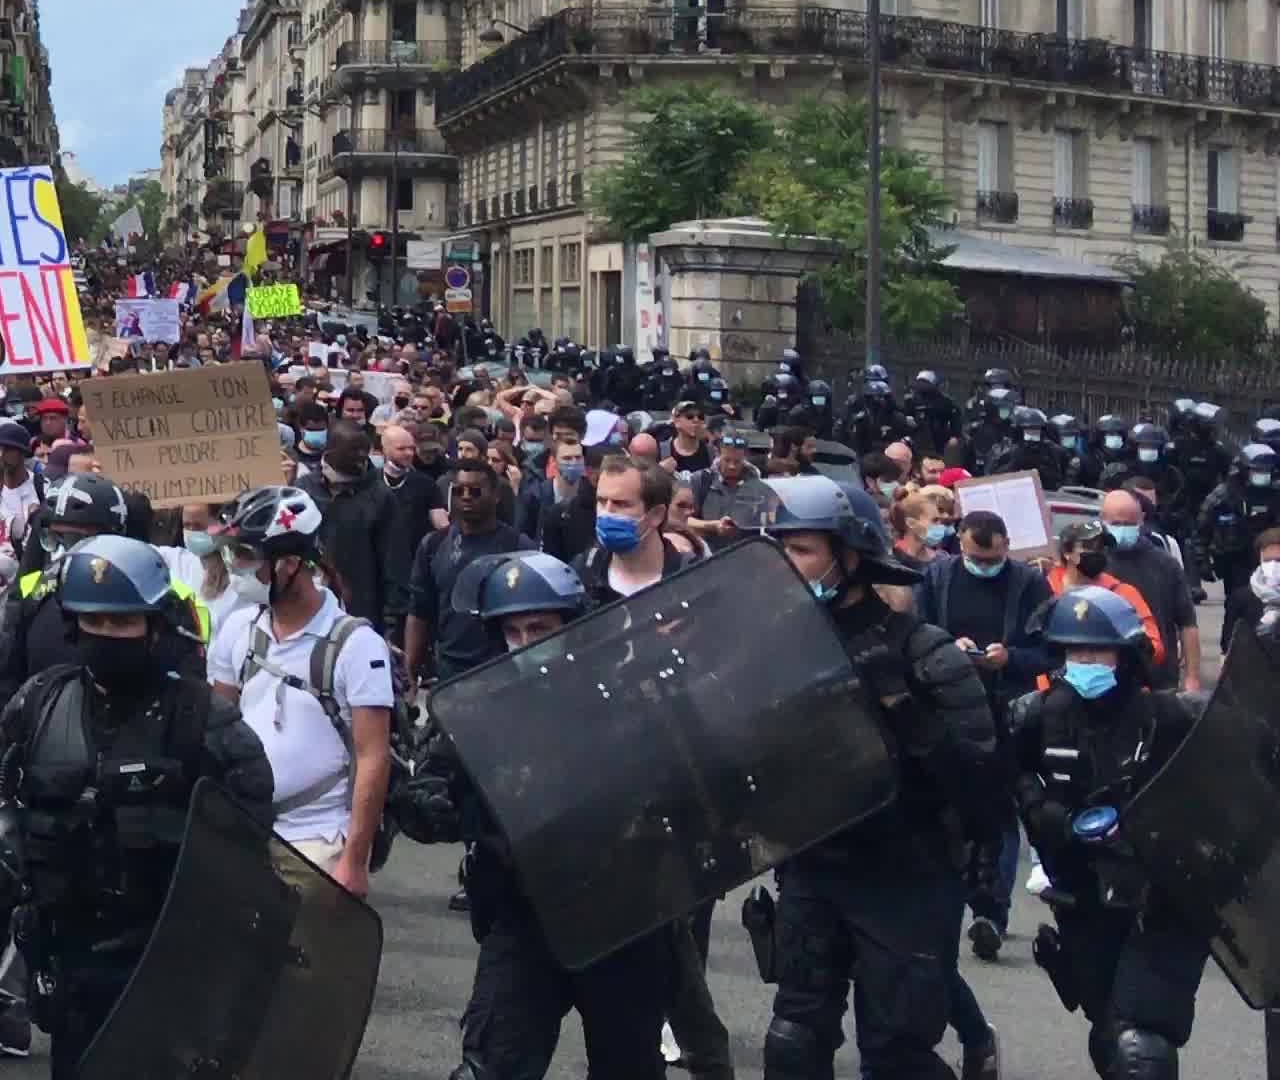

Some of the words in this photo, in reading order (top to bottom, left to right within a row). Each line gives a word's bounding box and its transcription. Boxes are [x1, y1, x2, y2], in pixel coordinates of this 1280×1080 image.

[208, 376, 248, 399] TON
[103, 414, 170, 441] VACCIN
[192, 402, 272, 433] CONTRE
[112, 448, 136, 471] TA
[158, 439, 221, 466] POUDRE
[236, 435, 262, 460] DE
